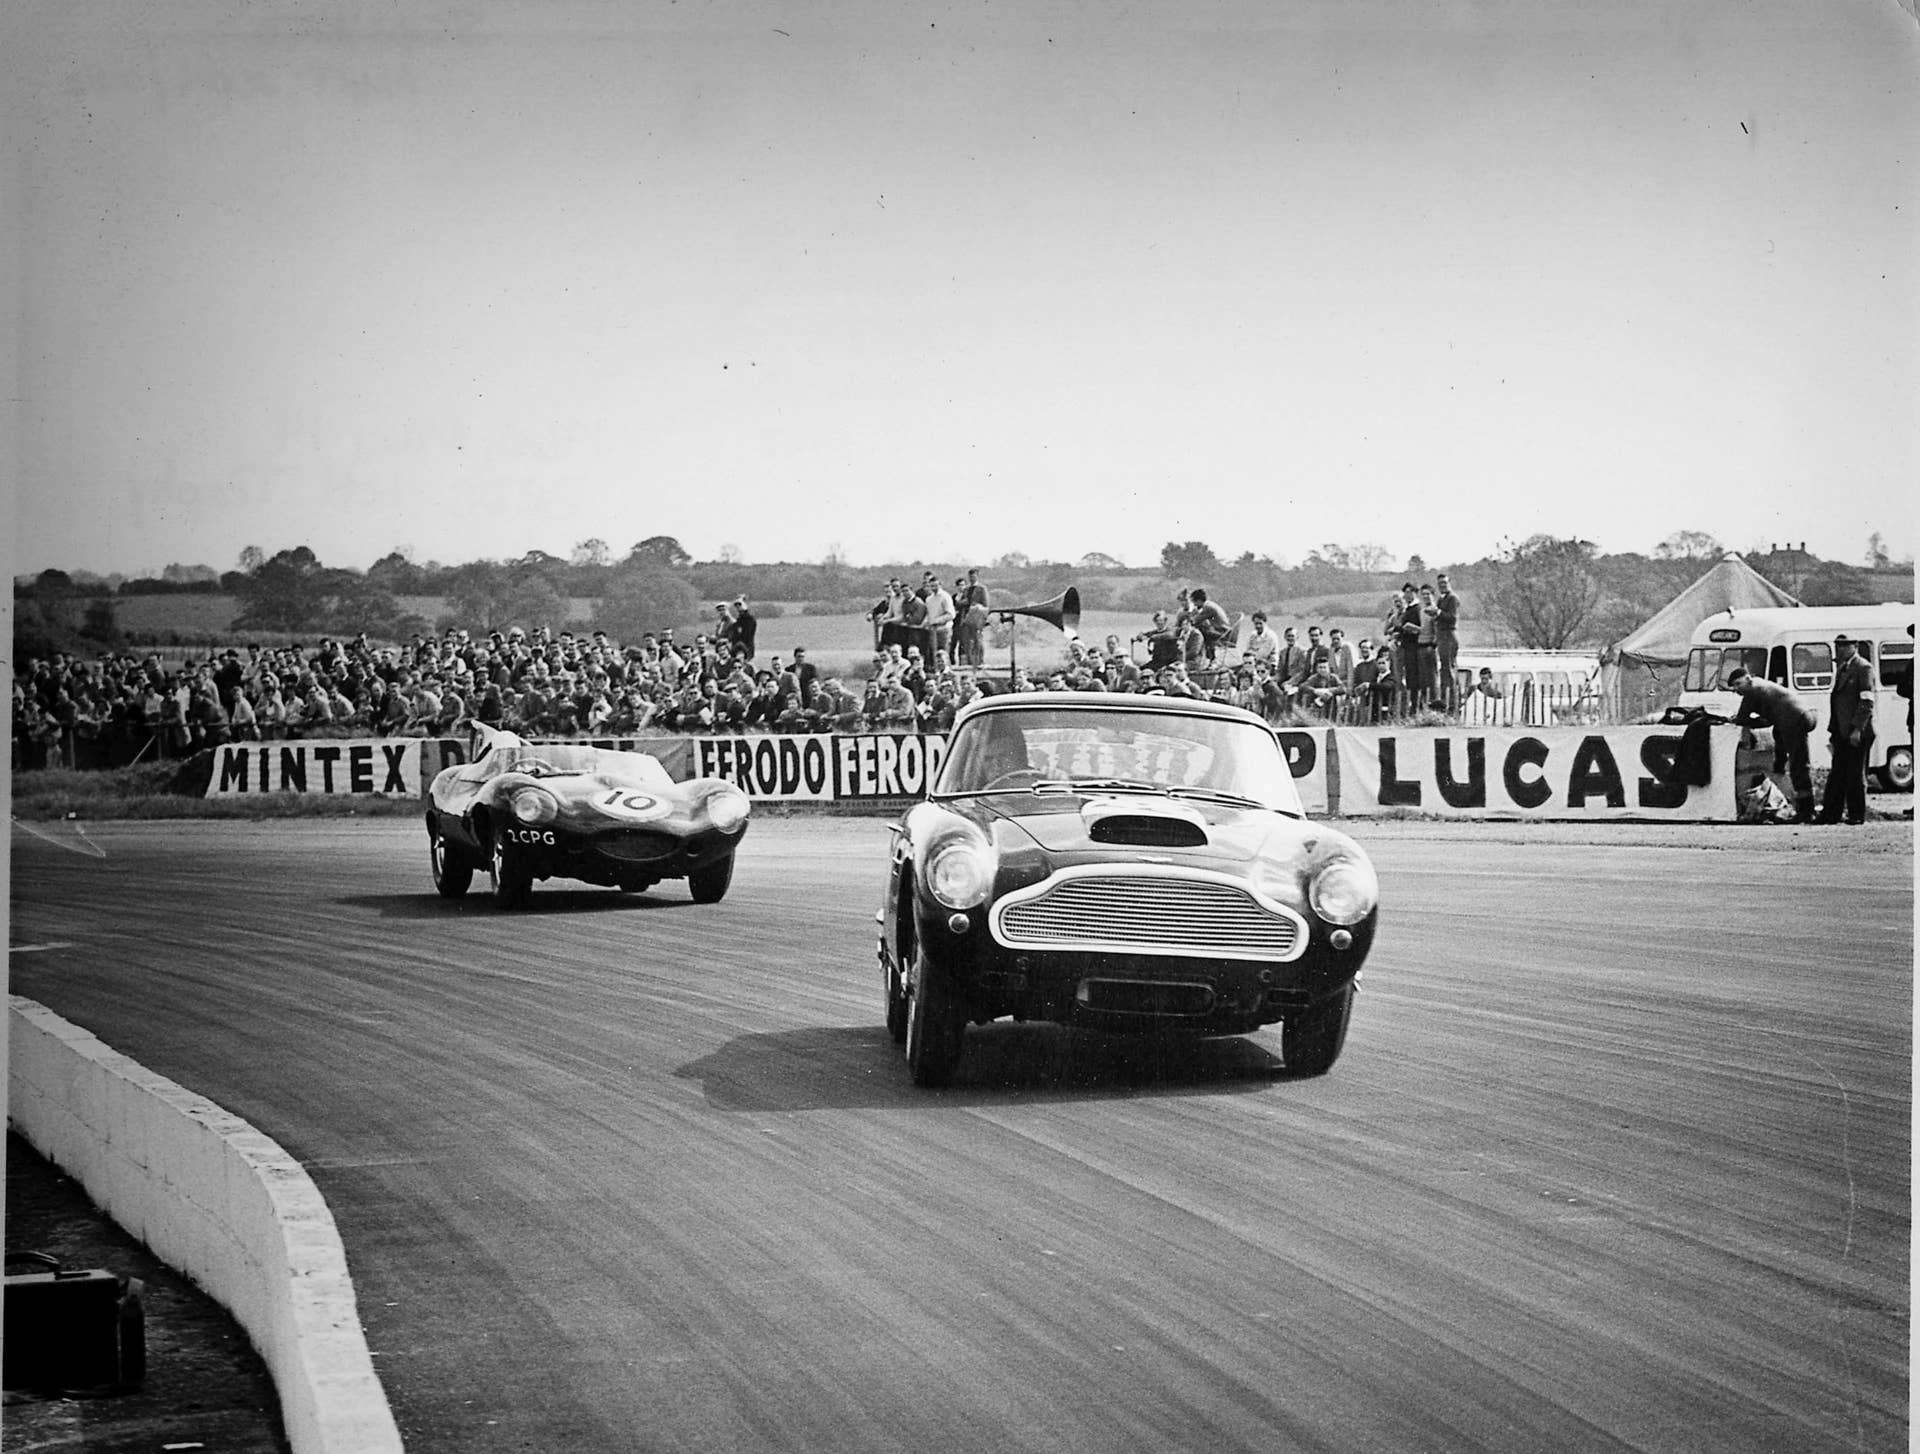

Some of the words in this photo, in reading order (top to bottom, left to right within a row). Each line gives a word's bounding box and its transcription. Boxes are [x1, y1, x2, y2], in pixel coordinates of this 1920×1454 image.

[219, 745, 406, 793] MINTEX
[700, 738, 826, 795] FERODO
[1378, 735, 1688, 808] LUCAS
[604, 791, 657, 810] 10
[507, 828, 556, 845] 2CPG
